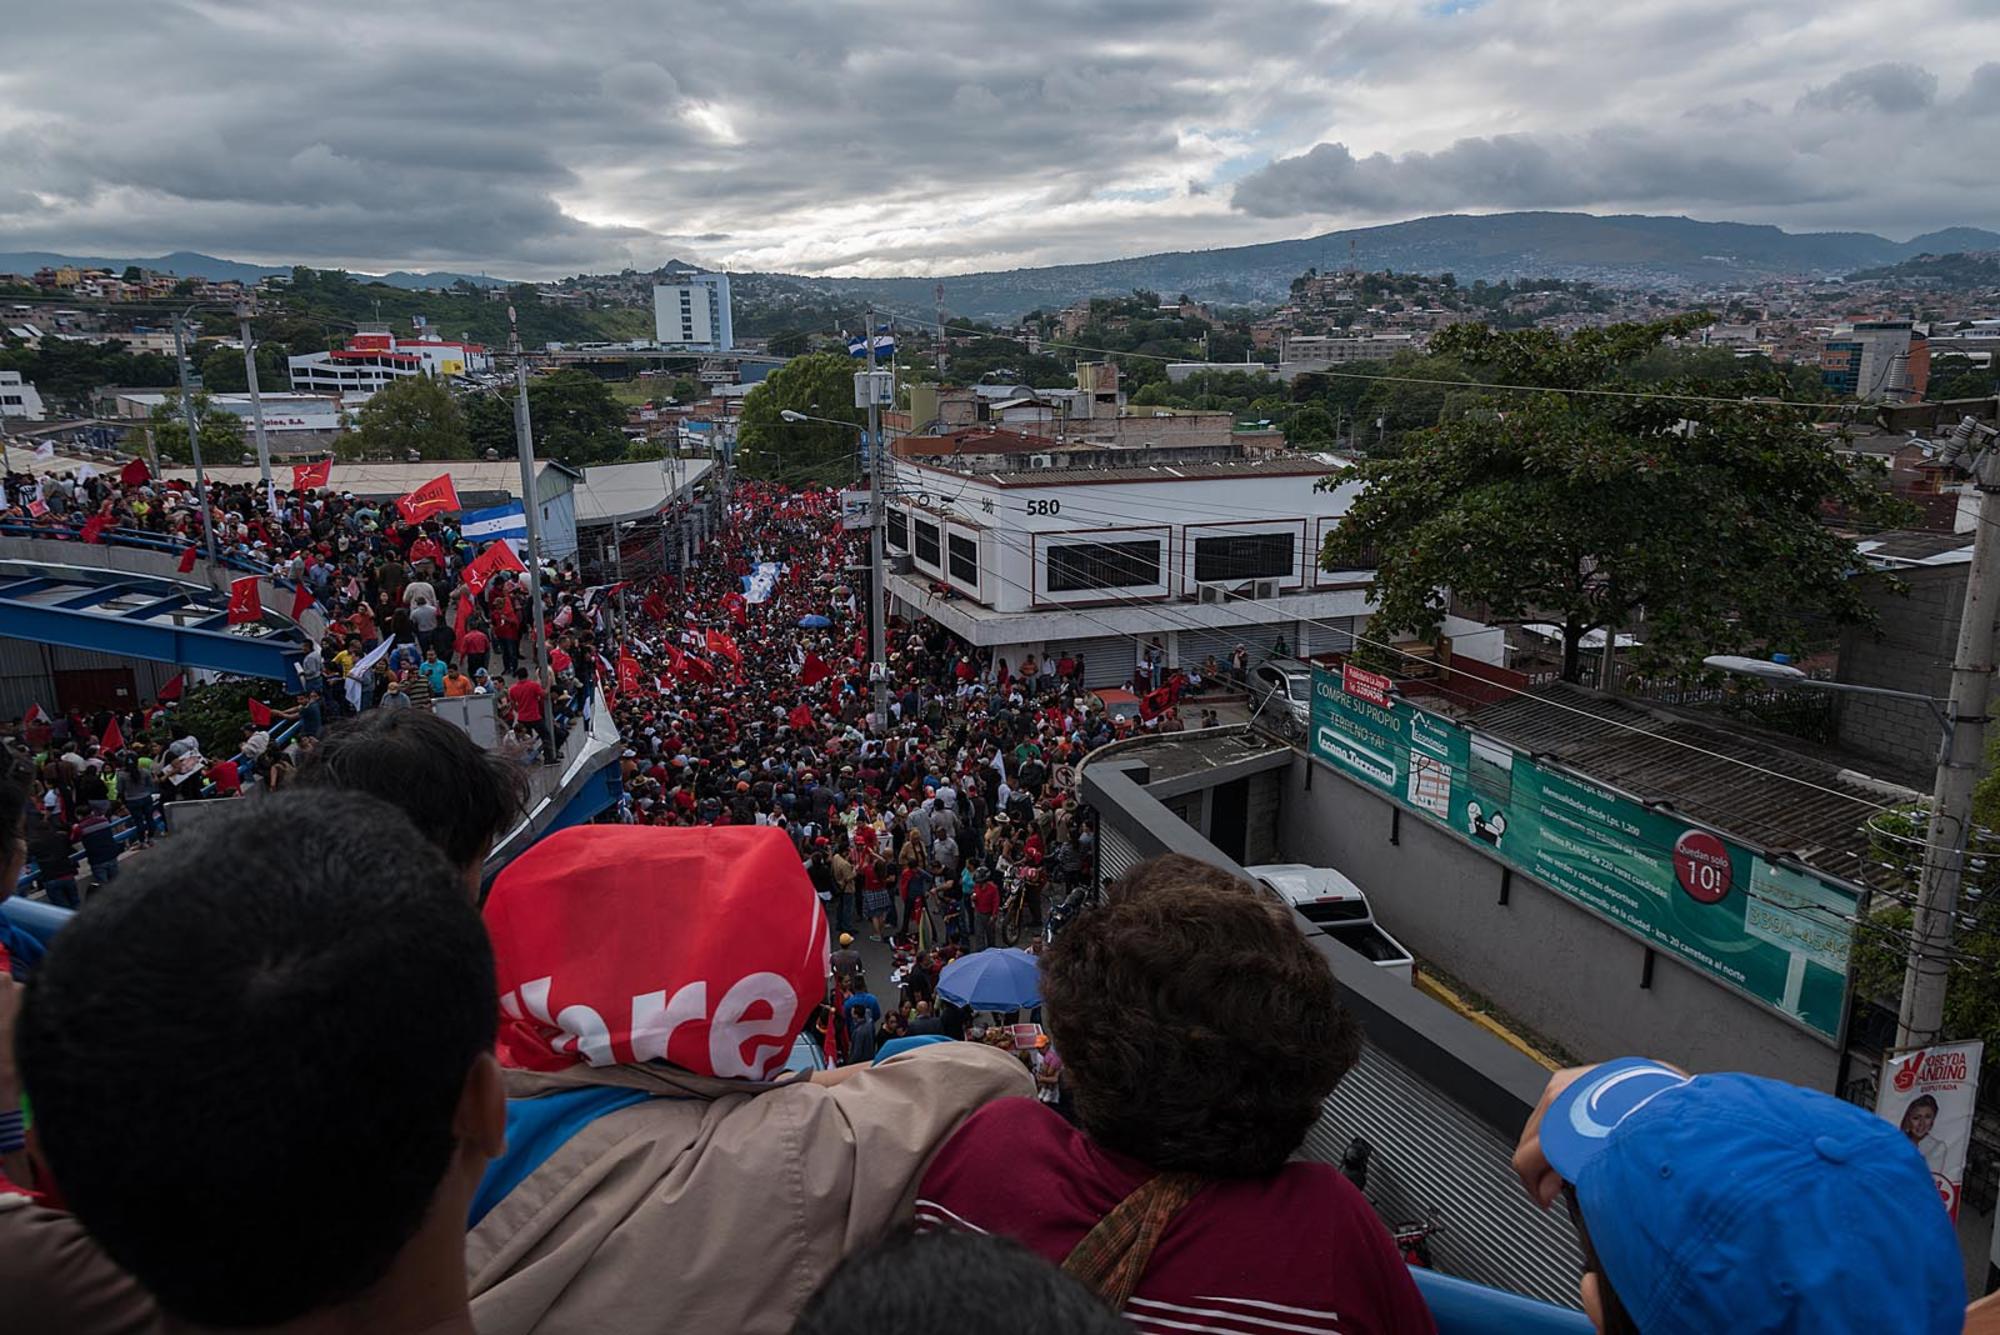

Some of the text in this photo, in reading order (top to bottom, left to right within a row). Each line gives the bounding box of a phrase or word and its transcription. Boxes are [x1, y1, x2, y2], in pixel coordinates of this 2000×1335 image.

[1027, 500, 1060, 516] 580
[1317, 682, 1400, 731] COMPRE SU PROPIO
[1330, 712, 1368, 741] TERRENO
[1586, 804, 1606, 821] desde
[1679, 843, 1728, 867] Quedan solo
[1687, 861, 1721, 894] 10!
[1536, 863, 1550, 878] Zona
[1550, 872, 1558, 882] de
[1610, 904, 1618, 915] de
[1620, 909, 1626, 919] la
[1628, 914, 1649, 932] ciudad
[1656, 928, 1669, 942] km.
[1679, 942, 1712, 965] carretera
[1714, 959, 1722, 970] al
[1723, 964, 1745, 983] norte
[1920, 1065, 1967, 1081] ANDINO
